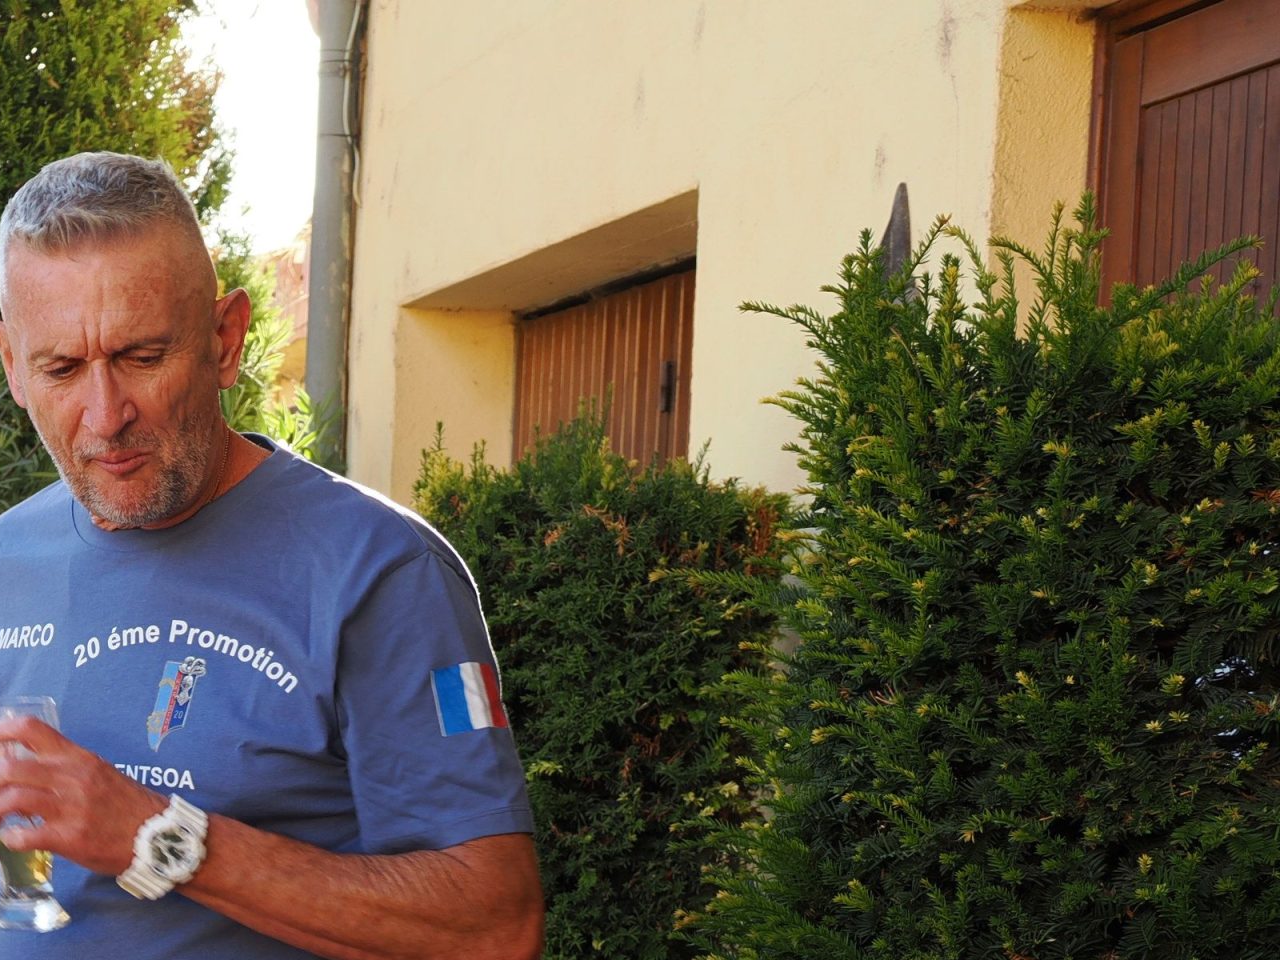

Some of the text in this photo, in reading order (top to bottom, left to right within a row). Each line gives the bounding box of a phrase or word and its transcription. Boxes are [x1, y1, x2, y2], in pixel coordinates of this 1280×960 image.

[73, 619, 299, 694] 20 éme Promotion
